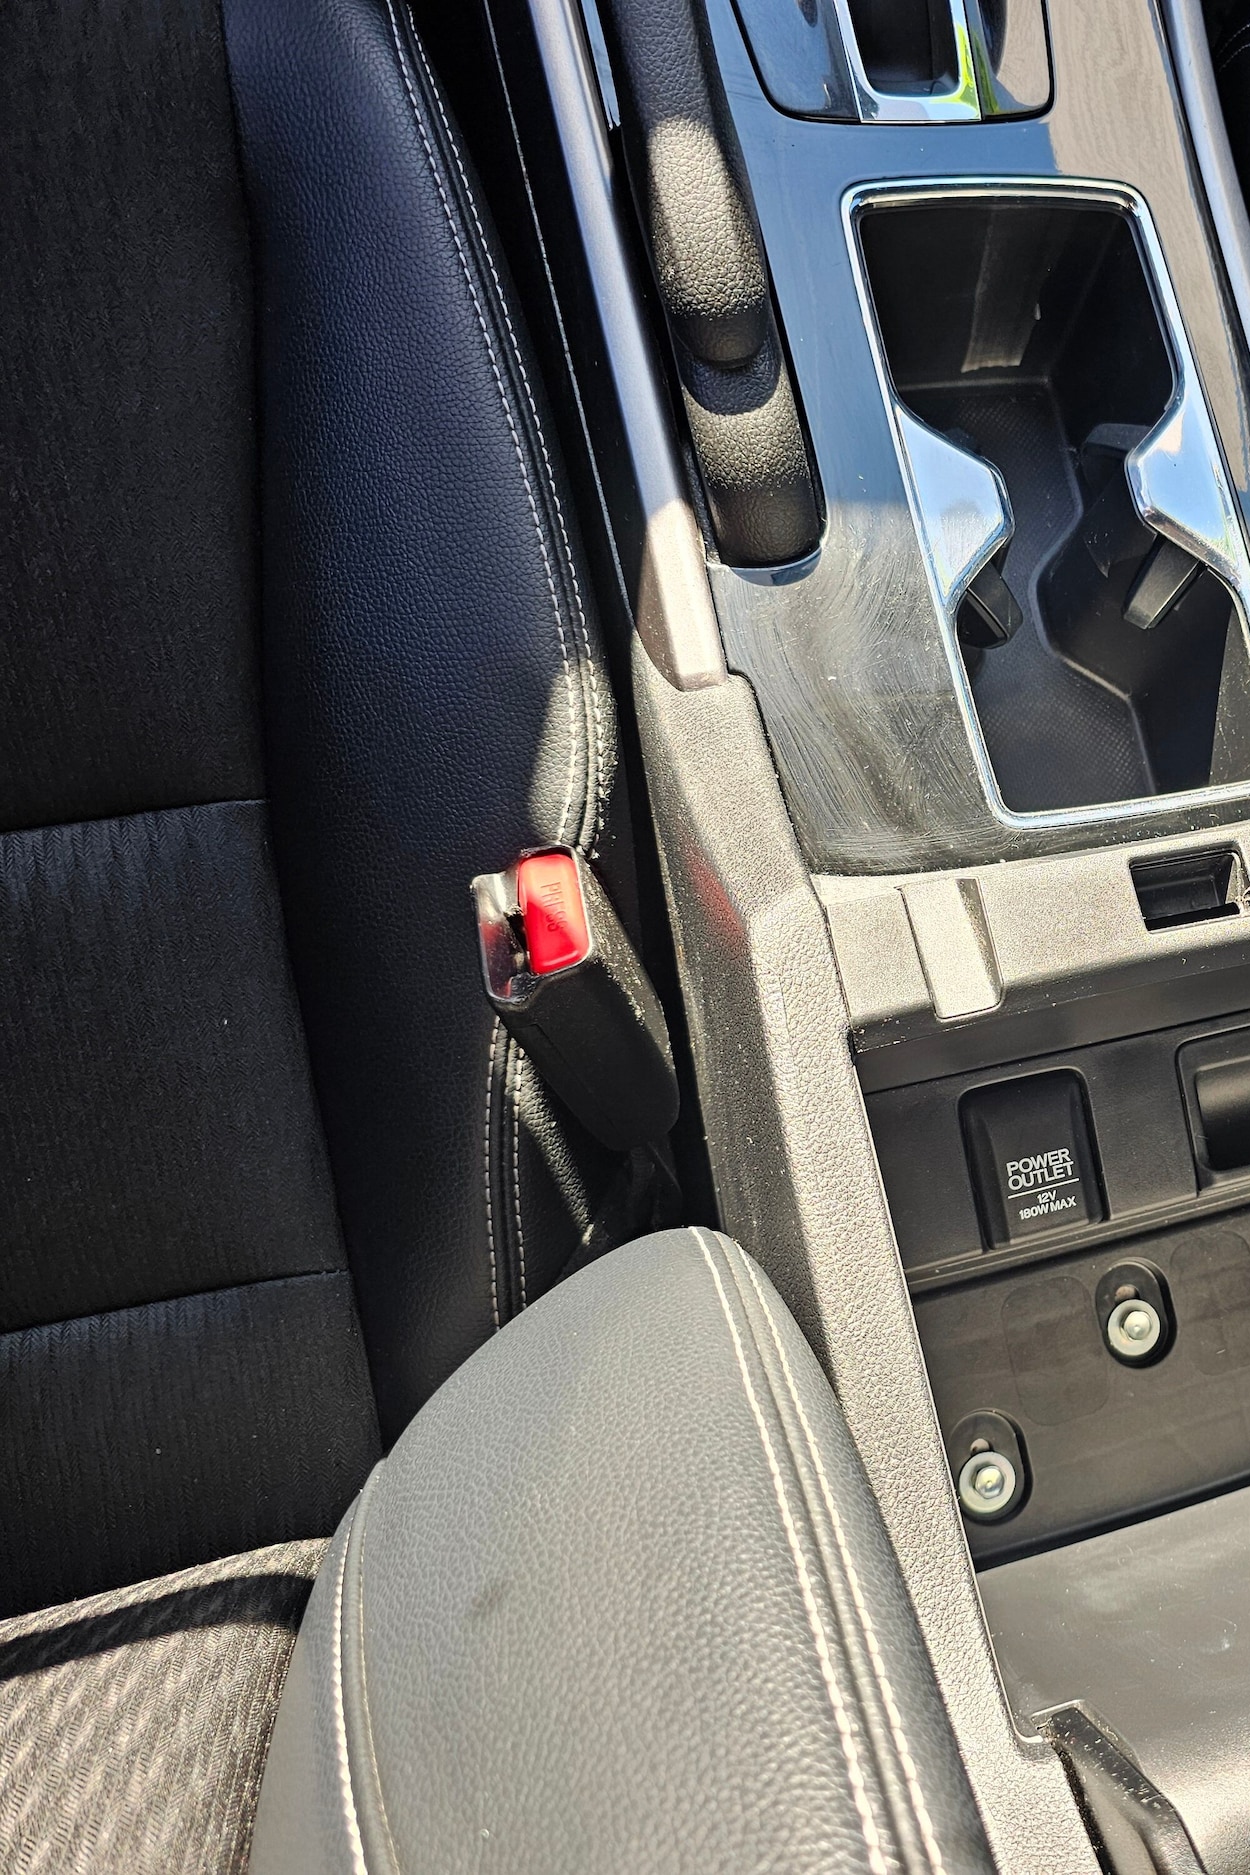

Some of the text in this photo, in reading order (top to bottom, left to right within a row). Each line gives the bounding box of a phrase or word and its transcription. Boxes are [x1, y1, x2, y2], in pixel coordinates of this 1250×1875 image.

[1006, 1148, 1072, 1177] POWER
[1008, 1161, 1074, 1191] OUTLET
[1019, 1196, 1077, 1220] 180W MAX
[1037, 1190, 1057, 1205] 12V
